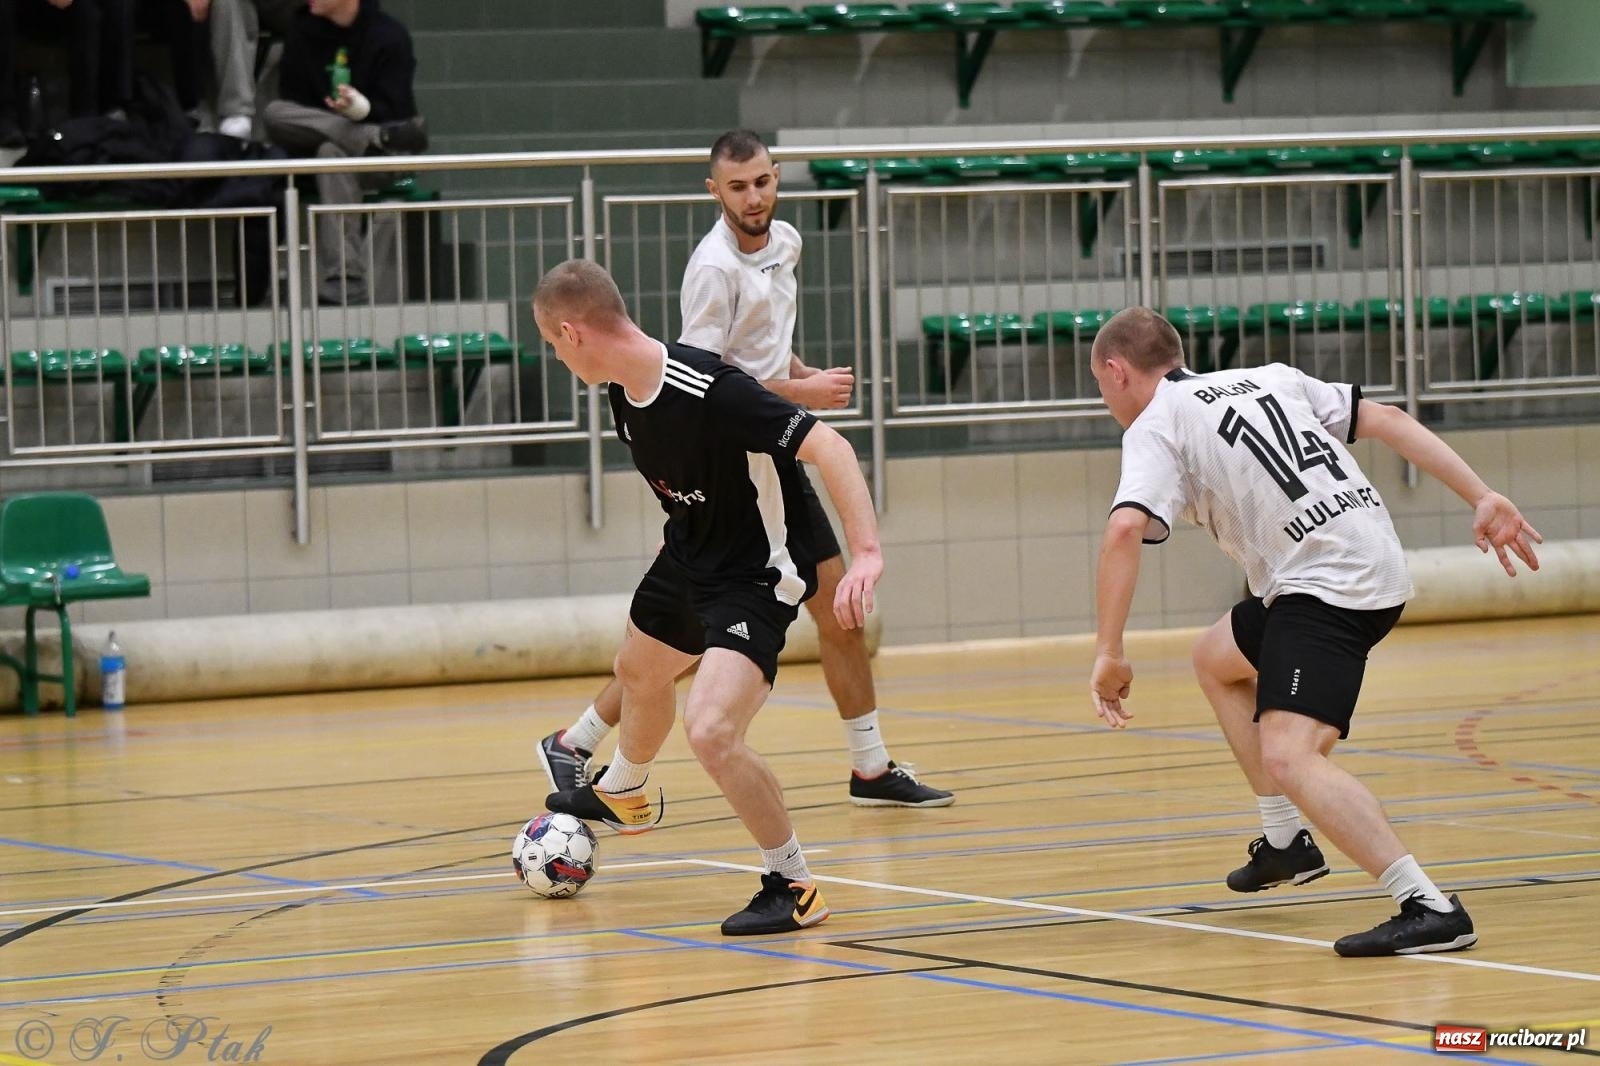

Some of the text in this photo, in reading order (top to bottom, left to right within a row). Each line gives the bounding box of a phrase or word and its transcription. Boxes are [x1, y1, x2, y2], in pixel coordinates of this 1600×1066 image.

[1217, 392, 1349, 503] 14
[1356, 487, 1381, 508] FC
[1290, 668, 1301, 695] KIPSTA
